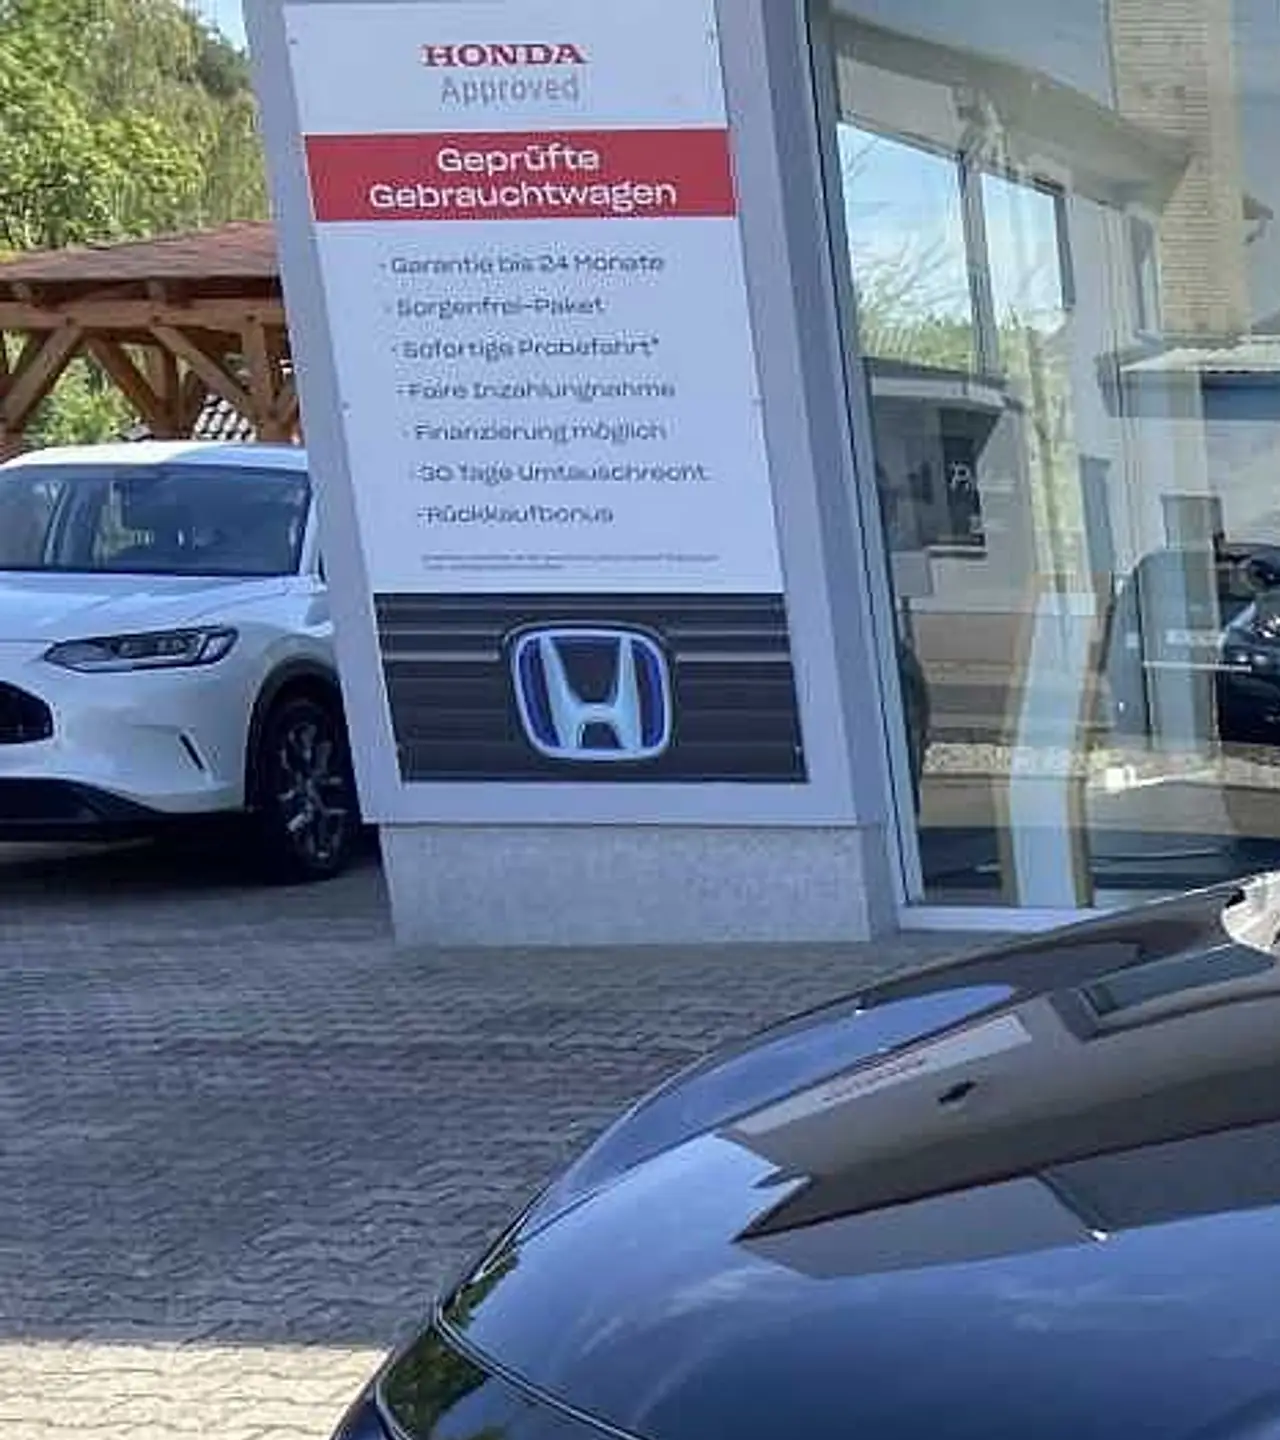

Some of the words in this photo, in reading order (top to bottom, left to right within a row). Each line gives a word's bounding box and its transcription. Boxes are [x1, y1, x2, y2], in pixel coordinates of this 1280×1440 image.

[421, 44, 588, 67] HONDA
[441, 75, 580, 105] Approved
[437, 143, 601, 176] Geprüfte
[368, 181, 678, 212] Gebrauchtwagen
[391, 257, 493, 274] Garantie
[500, 255, 533, 273] bis
[539, 255, 568, 272] 24
[573, 254, 665, 272] Monate
[403, 338, 514, 361] Sofortige
[415, 424, 568, 444] Finanzierung
[571, 422, 667, 444] möglich
[519, 464, 709, 482] Umtauschrecht
